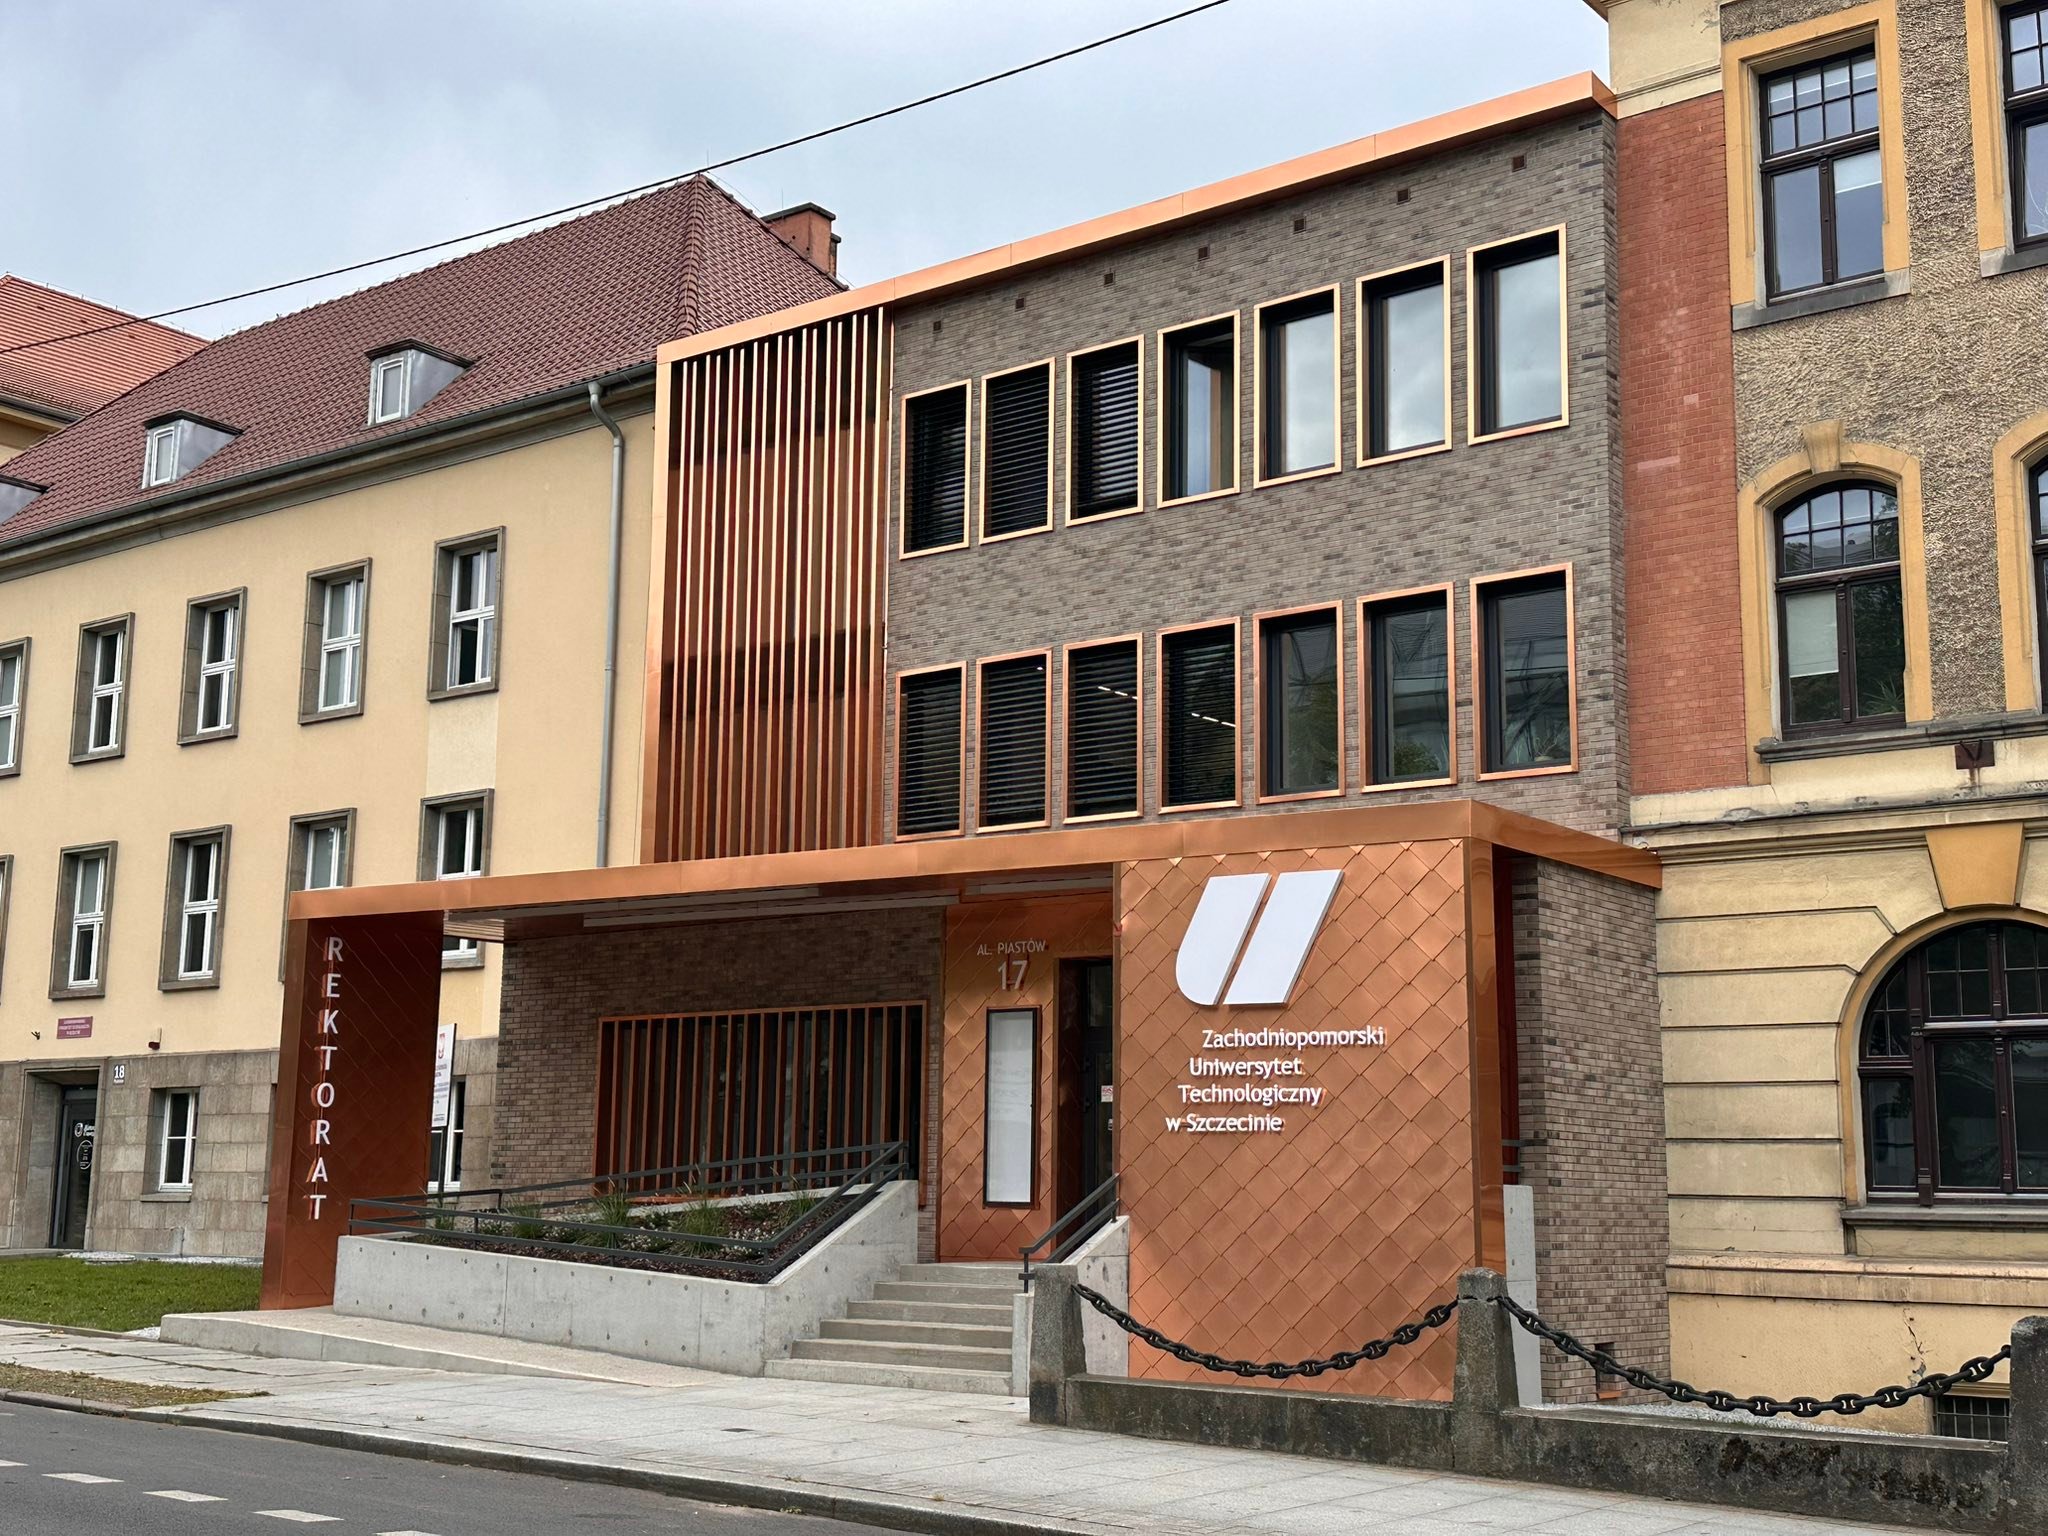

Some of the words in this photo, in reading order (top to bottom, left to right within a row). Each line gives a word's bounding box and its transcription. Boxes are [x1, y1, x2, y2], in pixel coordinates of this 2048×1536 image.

[977, 943, 992, 956] AL.
[998, 939, 1046, 954] PIASTÓW
[998, 960, 1028, 990] 17
[1202, 1026, 1385, 1050] Zachodniopomorski
[114, 1065, 125, 1079] 18
[310, 936, 343, 1220] REKTORAT
[1189, 1057, 1303, 1079] Uniwersytet
[1177, 1084, 1323, 1106] Technologiczny
[1165, 1116, 1181, 1132] w
[1186, 1113, 1283, 1133] Szczecinie
